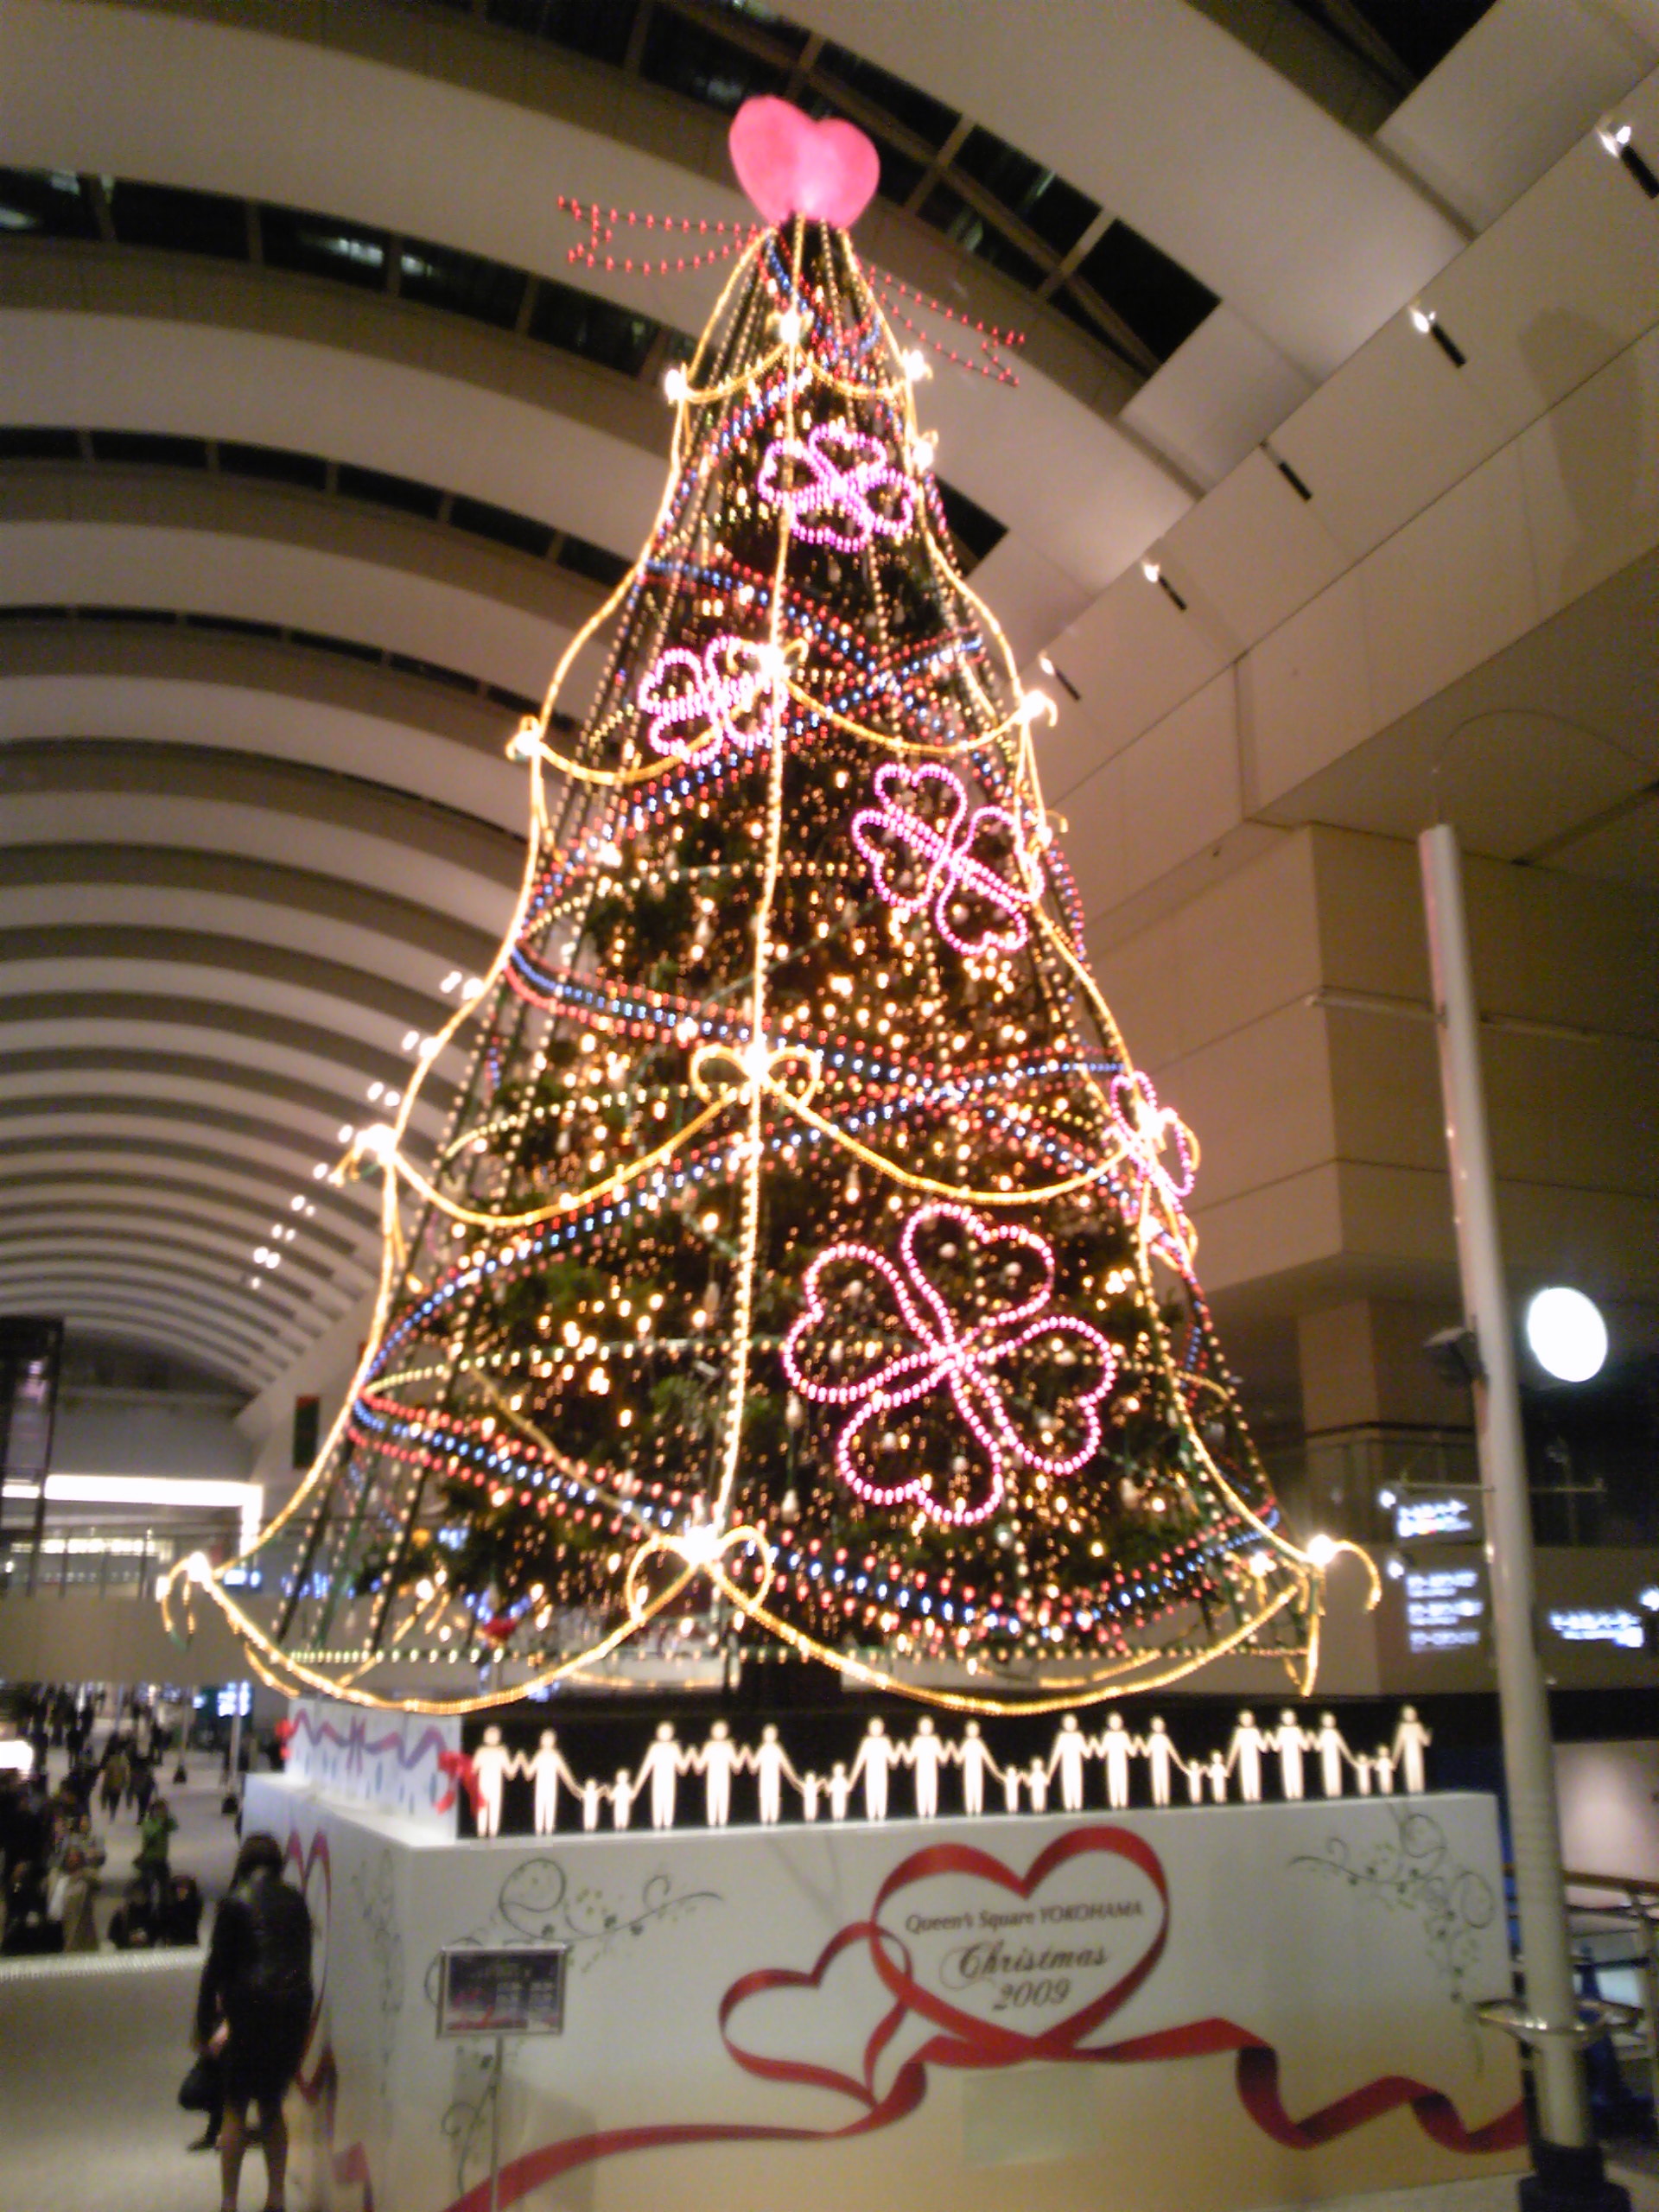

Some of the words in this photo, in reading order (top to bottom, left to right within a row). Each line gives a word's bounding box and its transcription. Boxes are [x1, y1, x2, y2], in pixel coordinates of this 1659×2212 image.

[905, 1911, 973, 1934] Queen's
[979, 1910, 1036, 1932] Square
[1040, 1902, 1142, 1923] YOKOHAMA
[947, 1939, 1108, 1983] Christmas
[992, 1978, 1071, 2011] 2009
